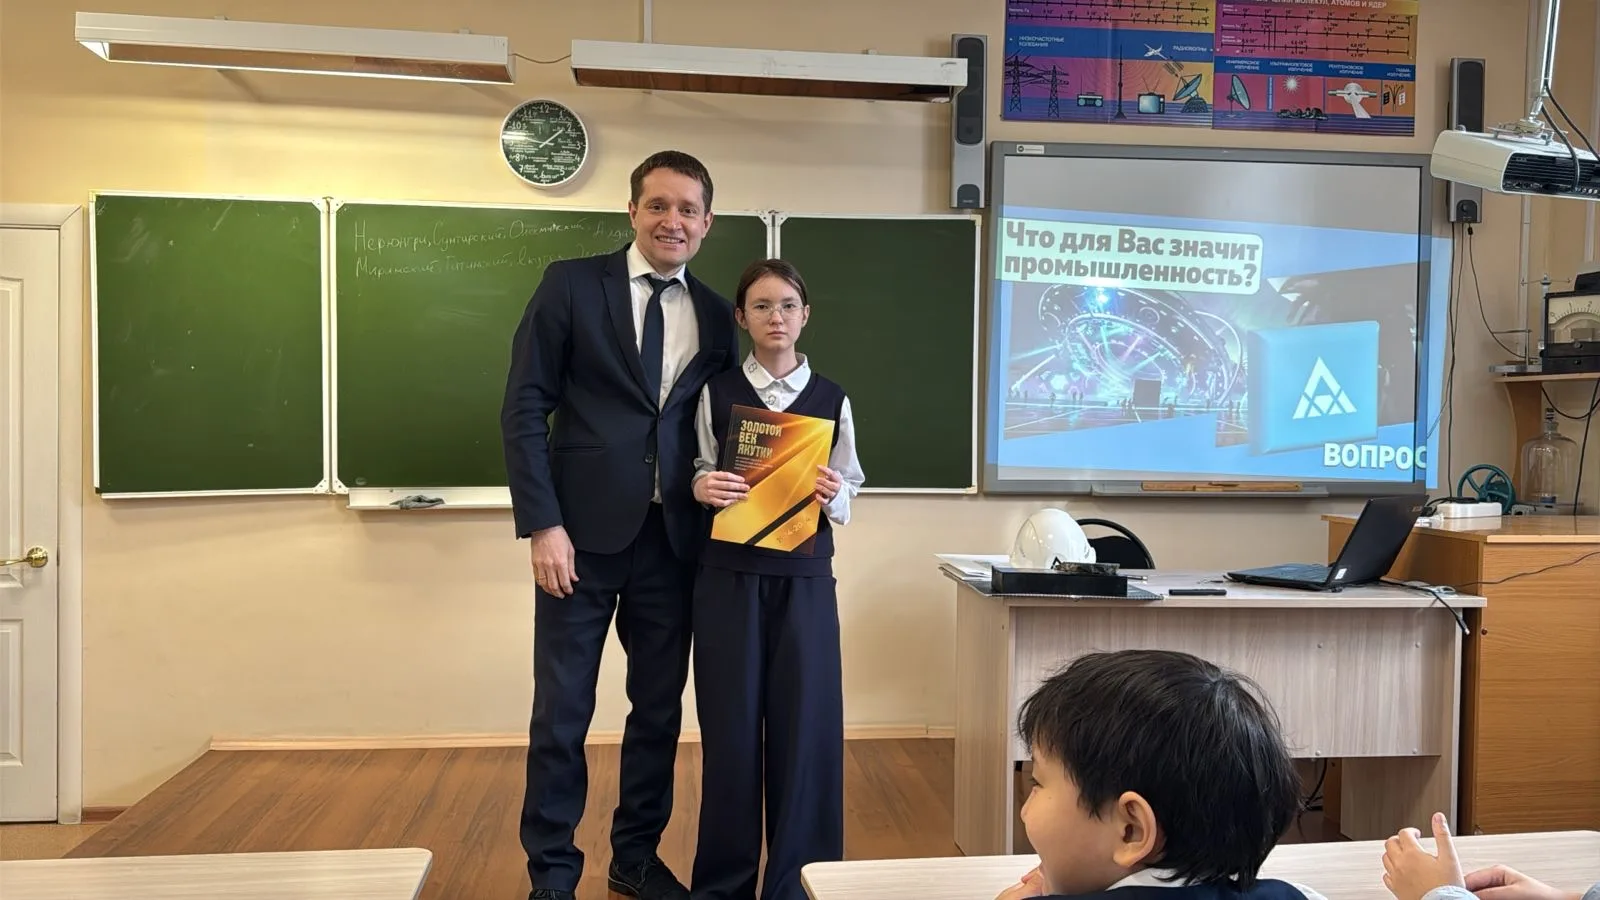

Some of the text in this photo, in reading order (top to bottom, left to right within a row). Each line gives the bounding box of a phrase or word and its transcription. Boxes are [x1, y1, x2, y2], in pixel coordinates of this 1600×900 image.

[541, 104, 550, 113] 12
[512, 121, 521, 129] 10
[515, 153, 520, 162] 8
[1006, 221, 1259, 262] Что для Вас значит
[1004, 255, 1257, 287] промышленность?
[740, 419, 783, 437] ЗОЛОТОЙ
[738, 431, 758, 445] ВЕК
[737, 443, 773, 459] ЯКУТИИ
[1324, 442, 1427, 470] ВОПРОС
